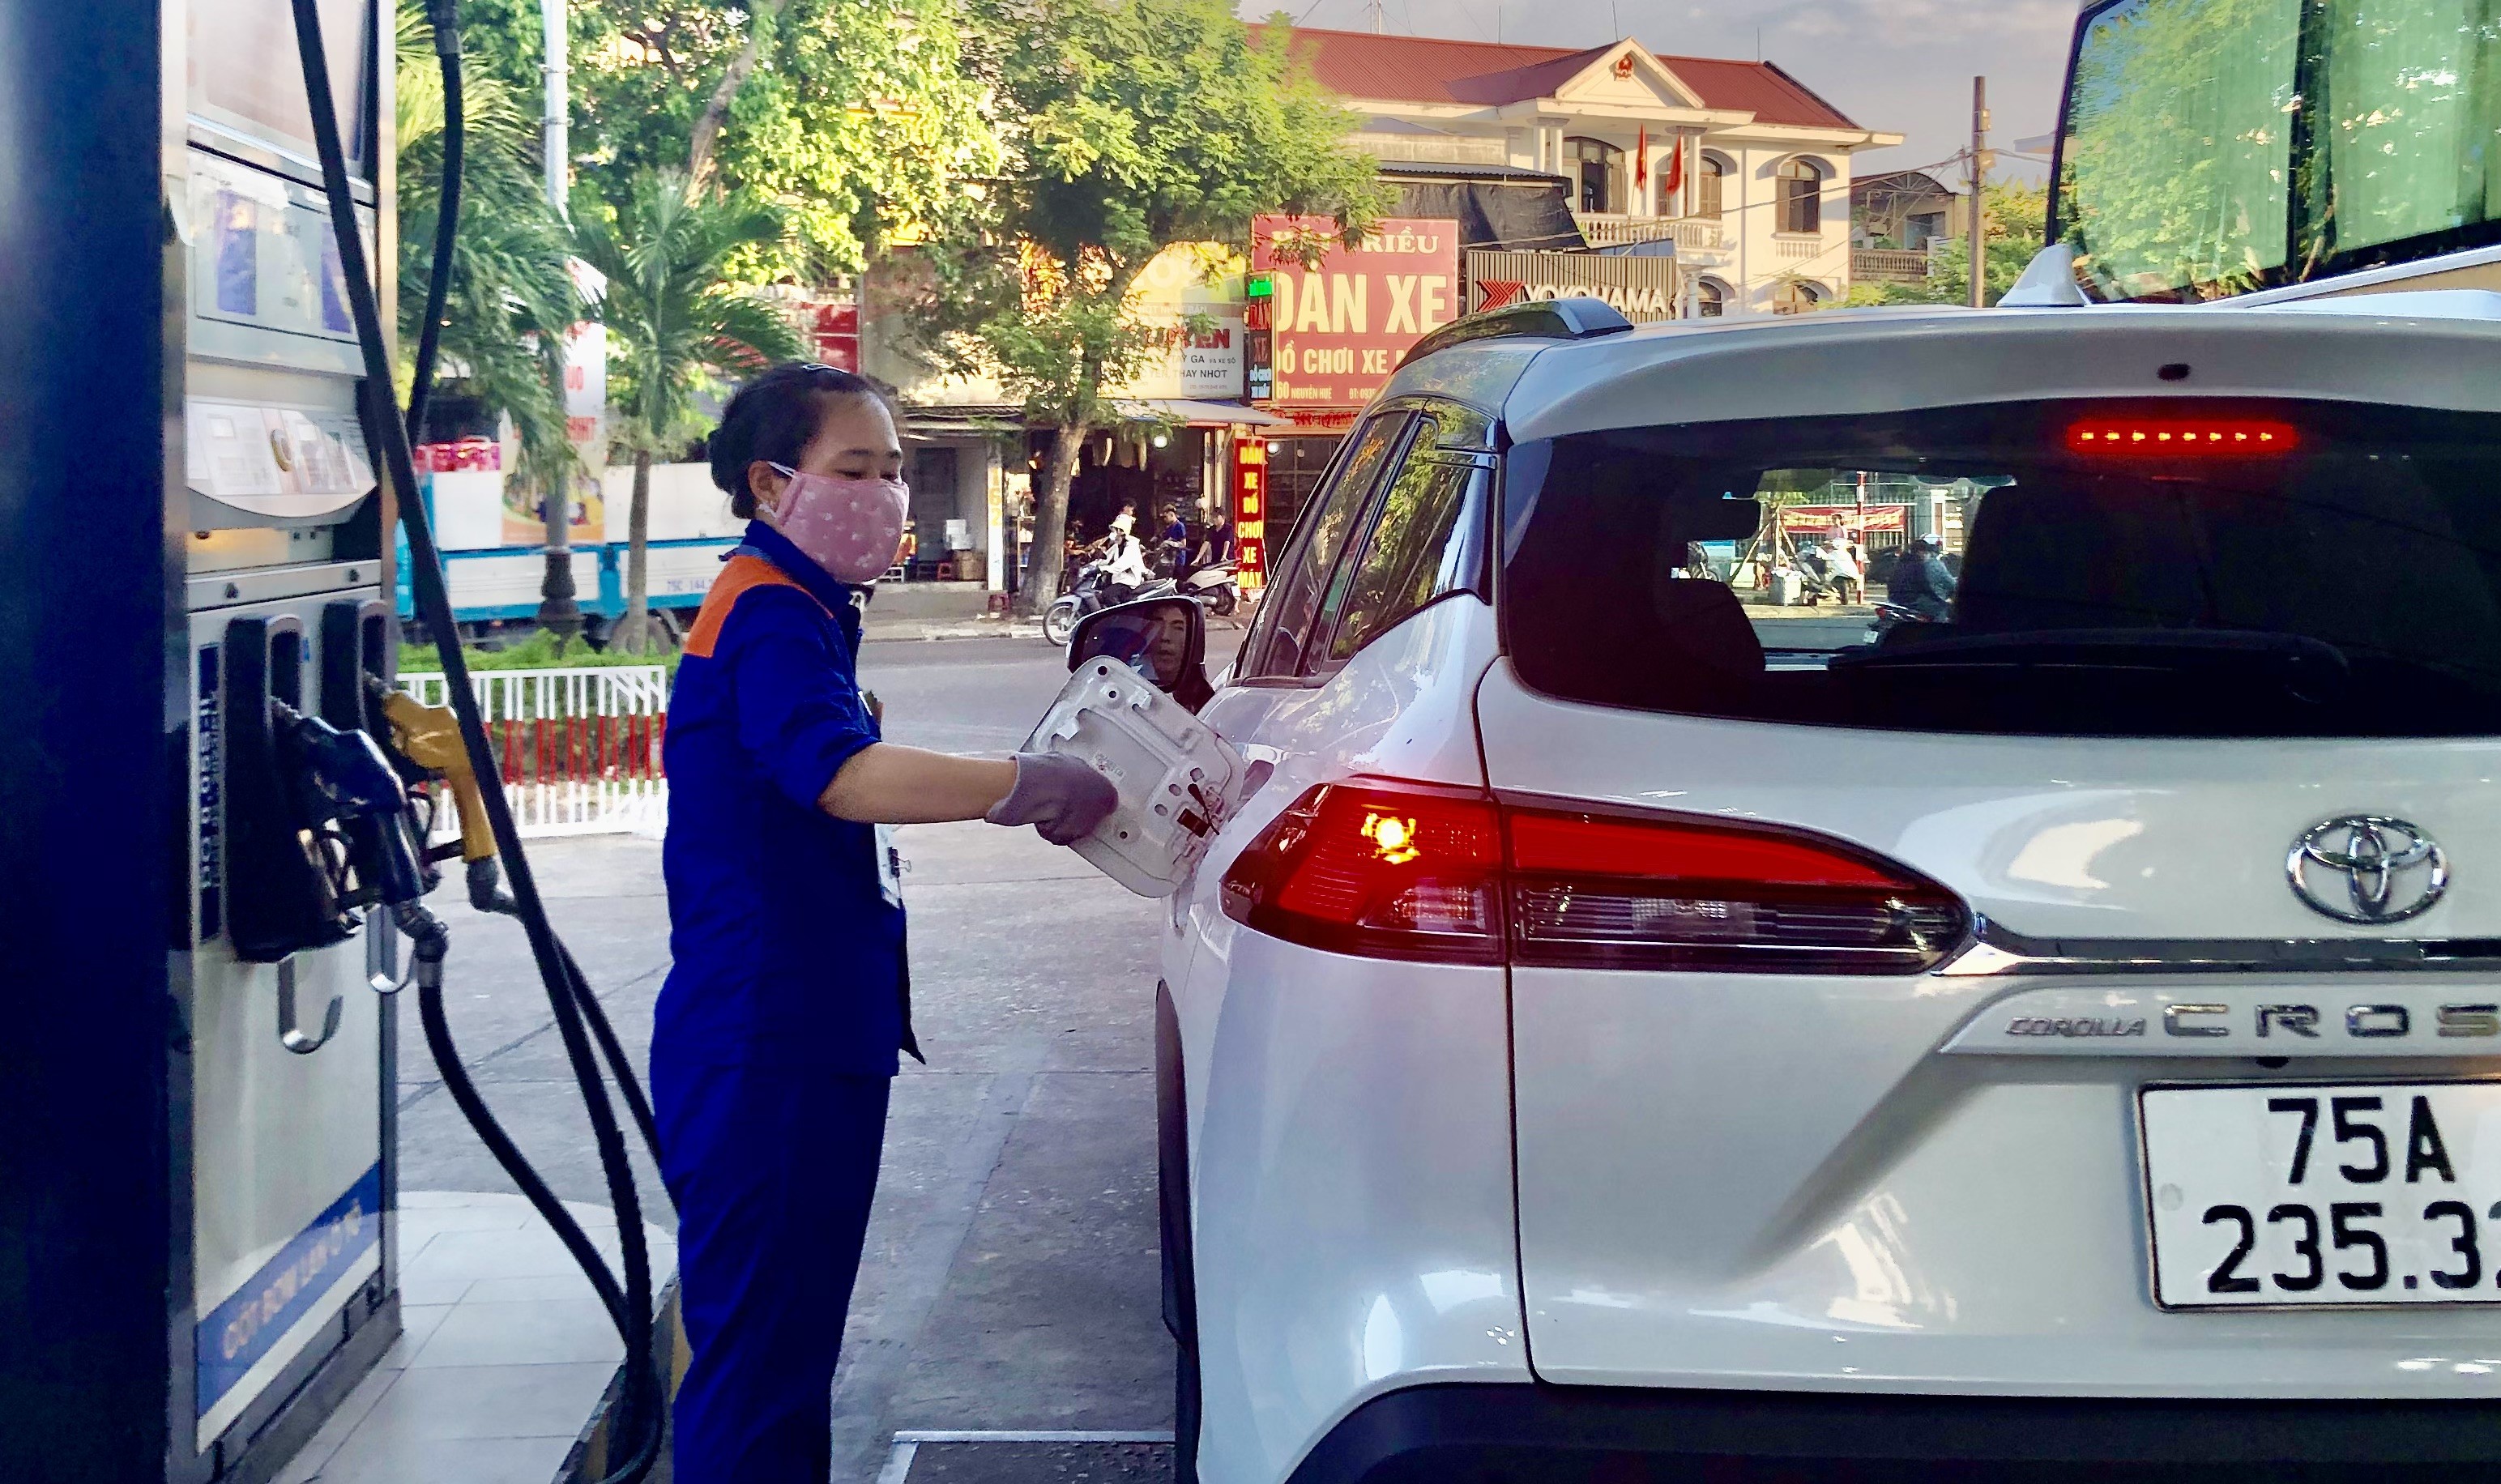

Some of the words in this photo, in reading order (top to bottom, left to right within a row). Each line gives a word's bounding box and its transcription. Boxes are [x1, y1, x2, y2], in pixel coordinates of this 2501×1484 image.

[1361, 225, 1439, 254] RIỀU
[1385, 274, 1448, 334] XE
[1190, 354, 1206, 364] GA
[1277, 339, 1296, 374] Ồ
[1303, 346, 1354, 375] CHƠI
[1361, 349, 1389, 374] XE
[1174, 369, 1198, 378] THAY
[1244, 471, 1258, 489] XE
[1237, 519, 1264, 539] CHƠI
[1242, 546, 1257, 564] XE
[1238, 569, 1262, 589] MÁY
[2005, 1016, 2147, 1038] COROLLA
[2267, 1096, 2456, 1185] 75A
[2201, 1200, 2501, 1295] 235.3
